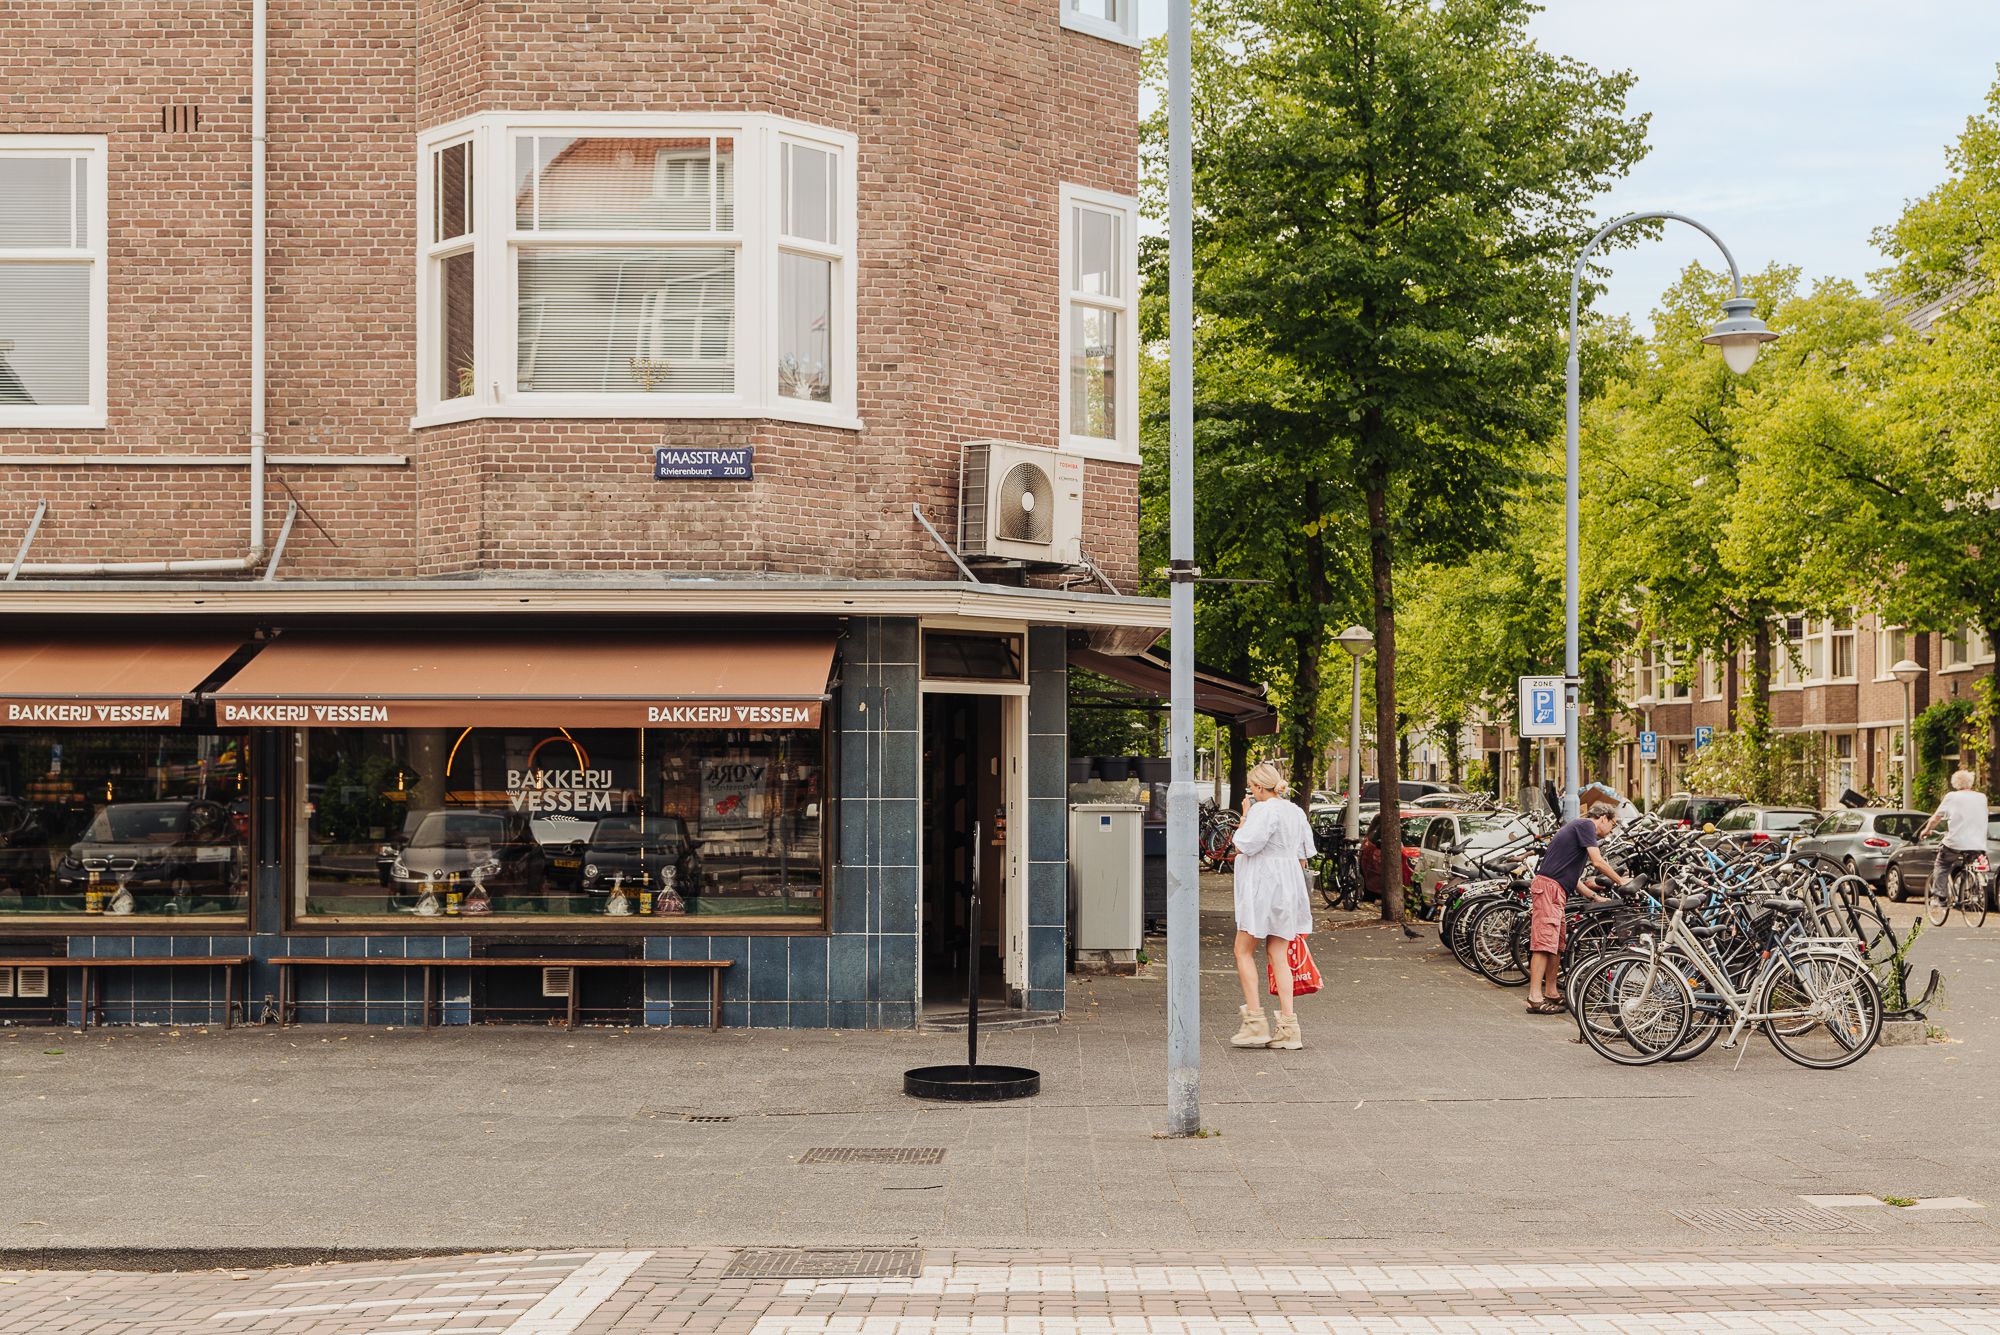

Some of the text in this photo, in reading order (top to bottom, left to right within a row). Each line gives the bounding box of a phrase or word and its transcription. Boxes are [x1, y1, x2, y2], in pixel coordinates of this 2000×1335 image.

[660, 451, 747, 464] MAASSTRAAT
[660, 467, 746, 475] Rivierenbuurt ZUID
[8, 704, 91, 721] BAKKERIJ
[97, 705, 170, 722] VESSEM
[225, 705, 309, 721] BAKKERIJ
[314, 705, 389, 722] VESSEM
[648, 706, 731, 722] BAKKERIJ
[736, 706, 809, 723] VESSEM
[507, 769, 612, 789] BAKKERIJ
[511, 791, 612, 812] VESSEM
